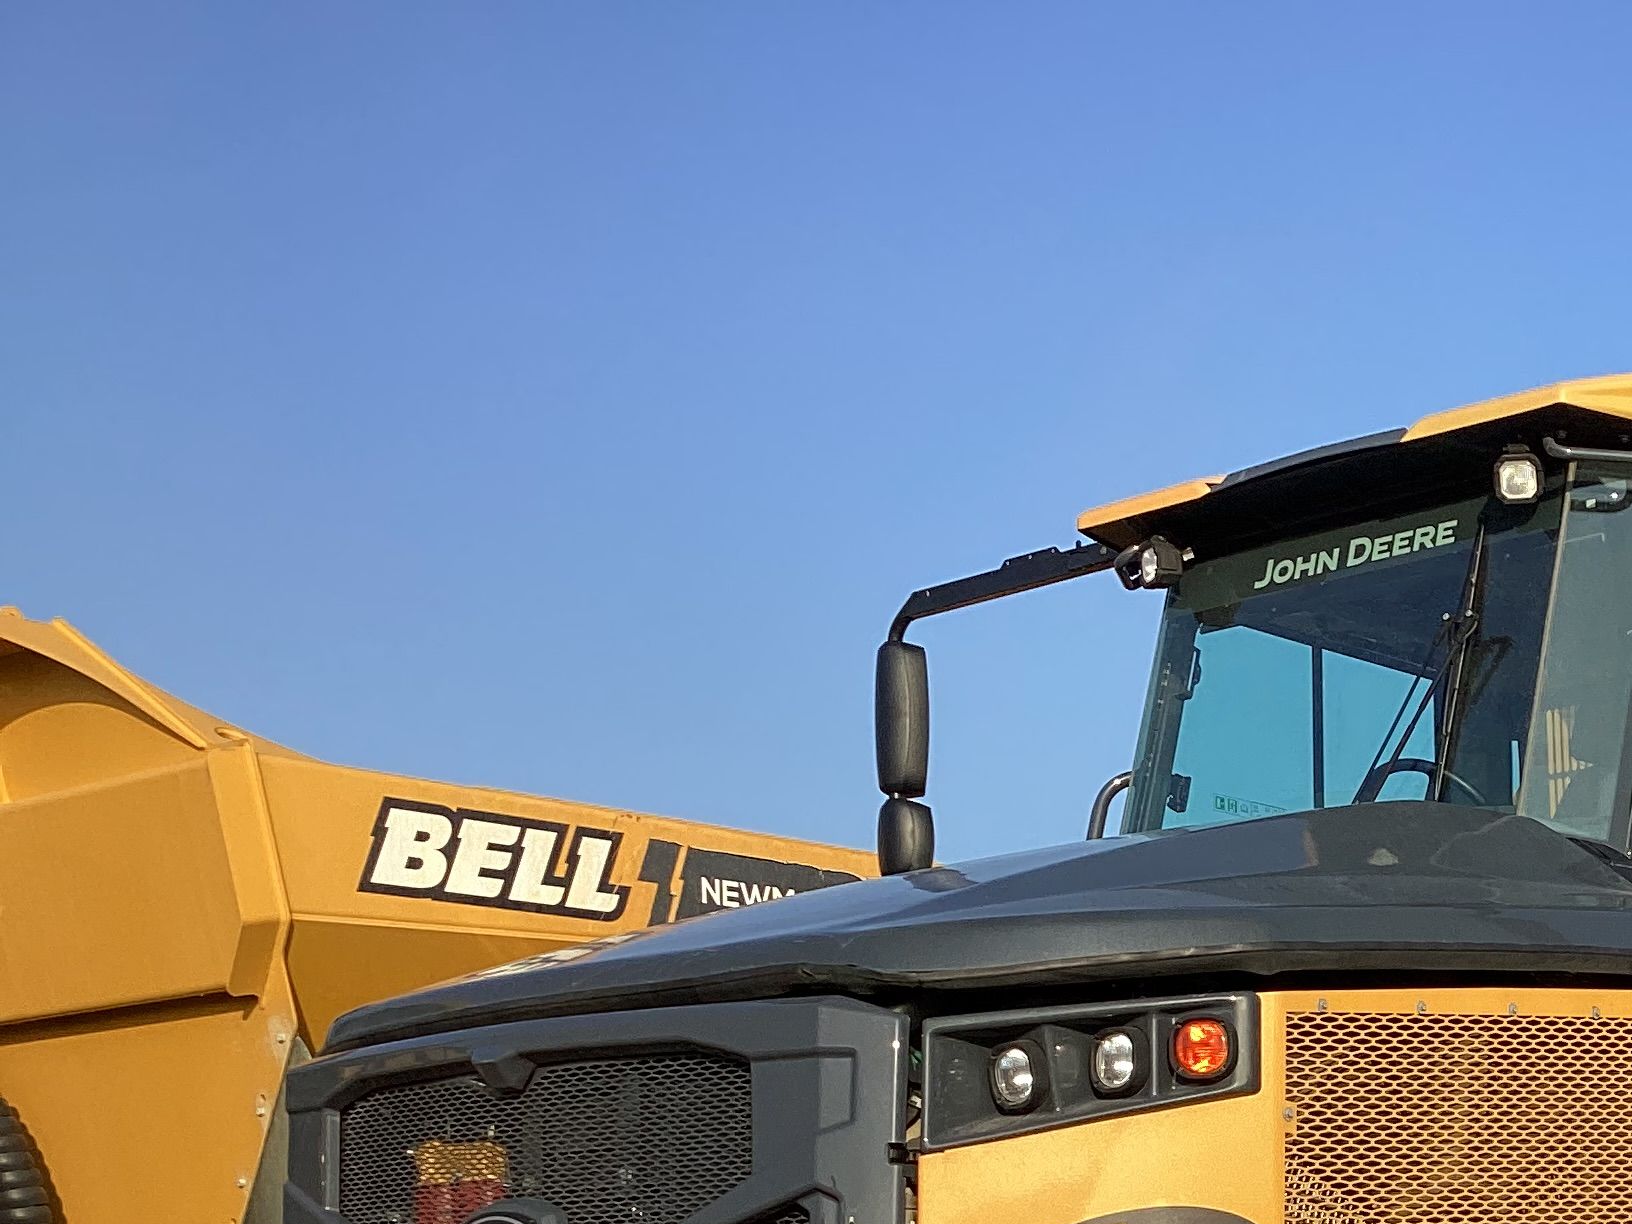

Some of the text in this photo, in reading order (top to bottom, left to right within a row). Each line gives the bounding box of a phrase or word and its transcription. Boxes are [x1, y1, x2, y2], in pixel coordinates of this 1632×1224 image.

[1253, 519, 1458, 589] JOHN DEERE
[369, 807, 628, 914] BELL
